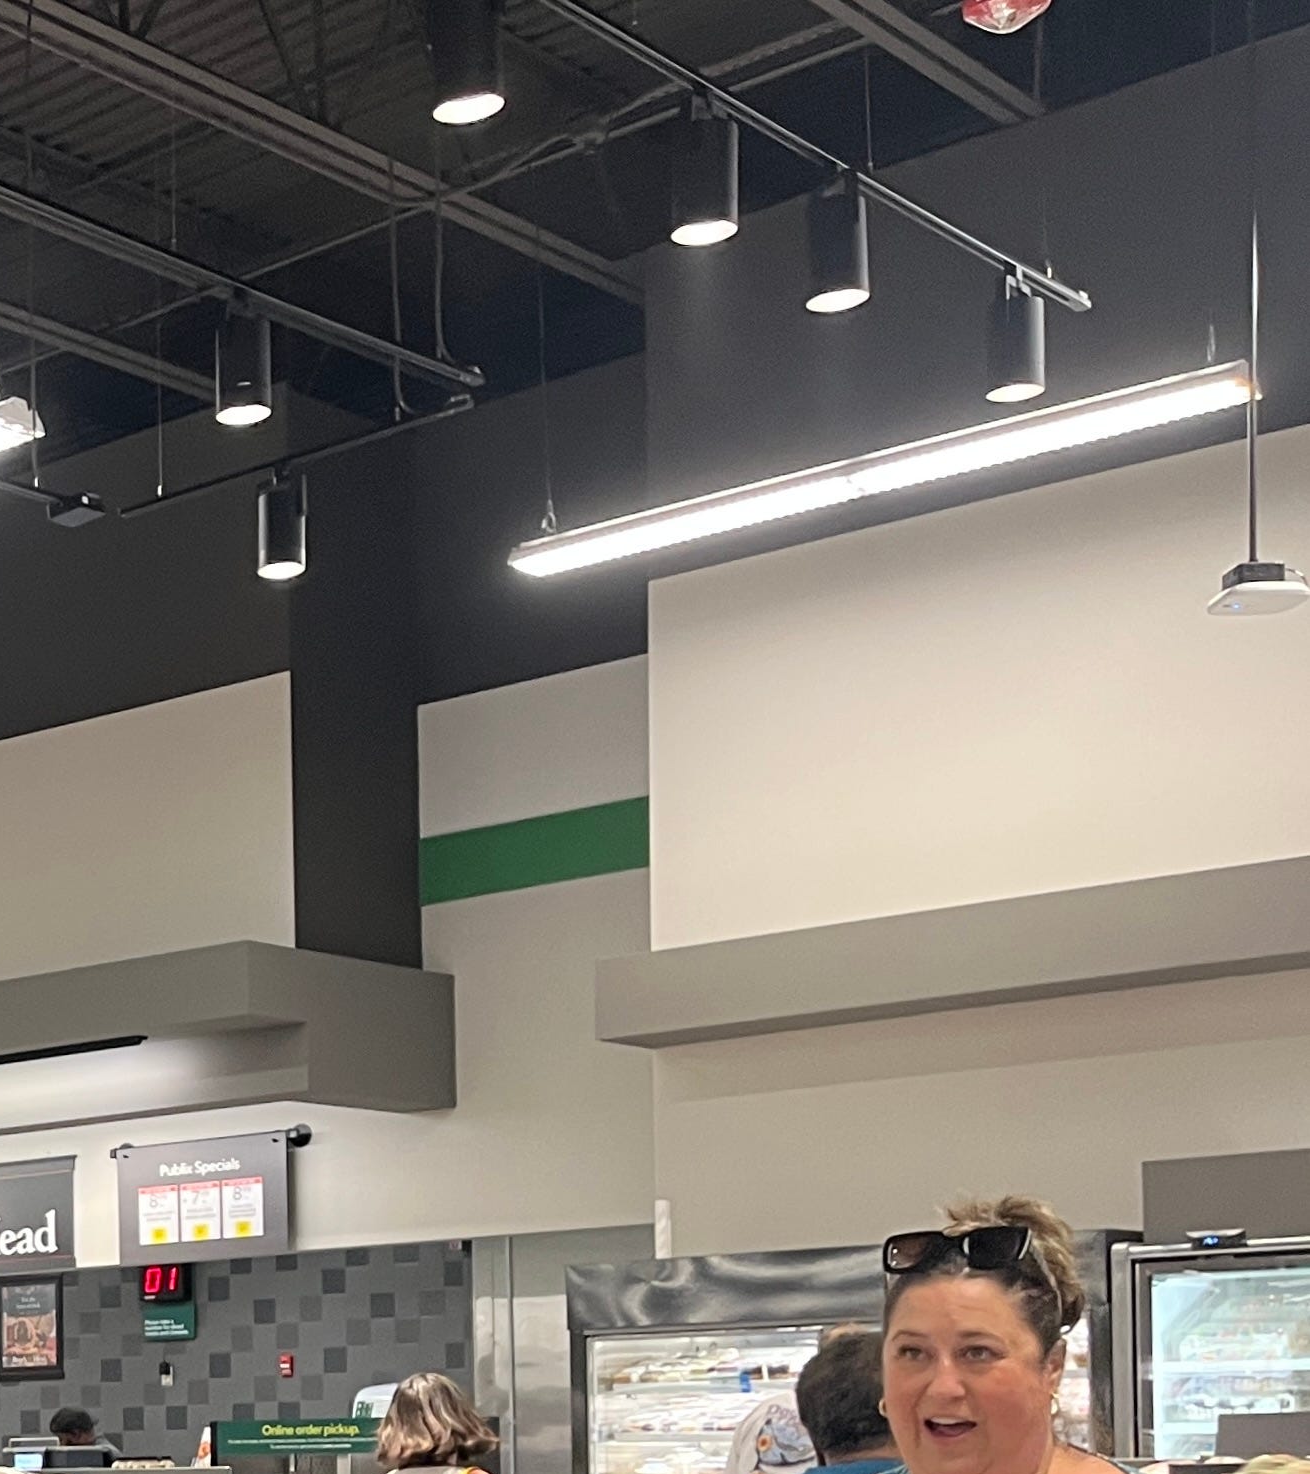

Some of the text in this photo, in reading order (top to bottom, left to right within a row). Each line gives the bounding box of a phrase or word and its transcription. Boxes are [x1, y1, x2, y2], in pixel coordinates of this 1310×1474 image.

[159, 1157, 241, 1177] Publix Specials
[145, 1267, 177, 1293] 01
[261, 1424, 294, 1436] Online
[295, 1424, 323, 1435] order
